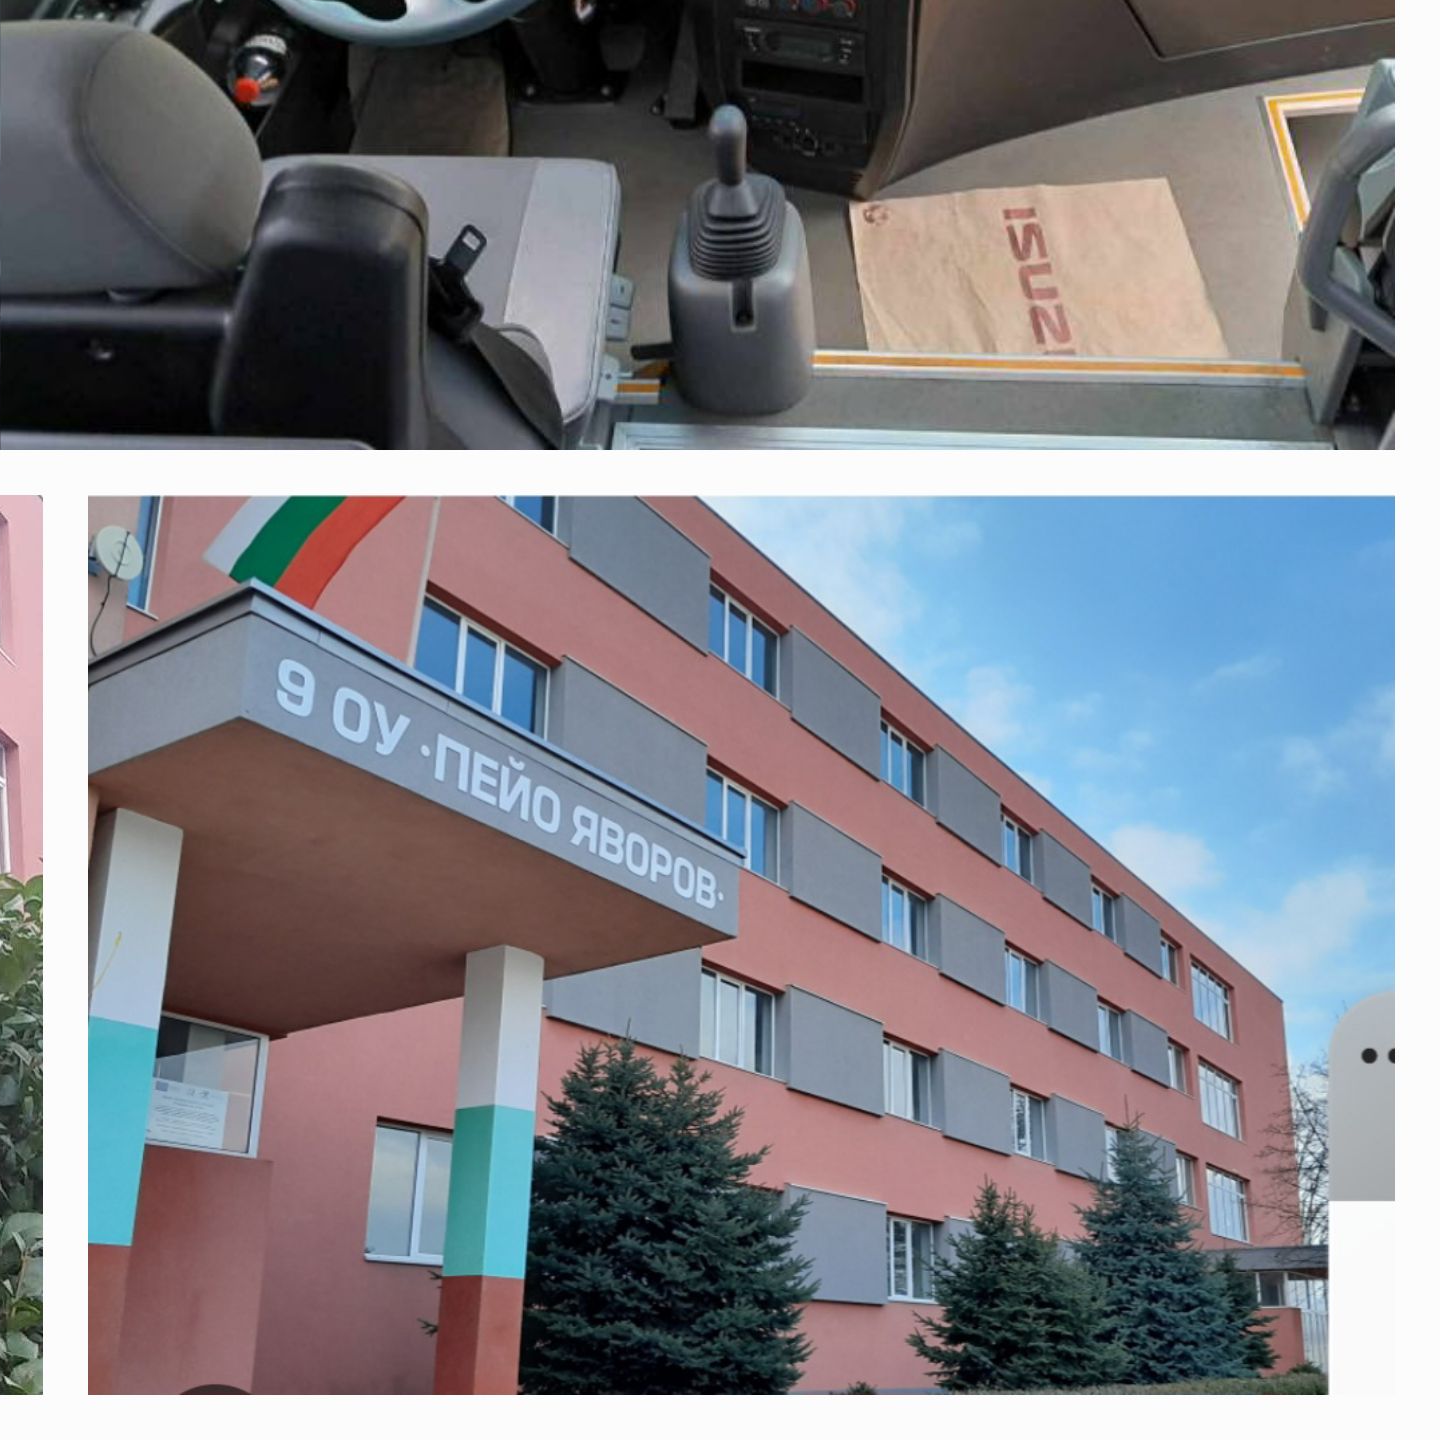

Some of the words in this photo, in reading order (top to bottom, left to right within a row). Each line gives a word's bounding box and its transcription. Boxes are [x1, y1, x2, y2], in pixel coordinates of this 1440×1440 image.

[1002, 208, 1076, 355] ISUZ
[276, 658, 317, 718] 9
[332, 686, 411, 756] ОУ
